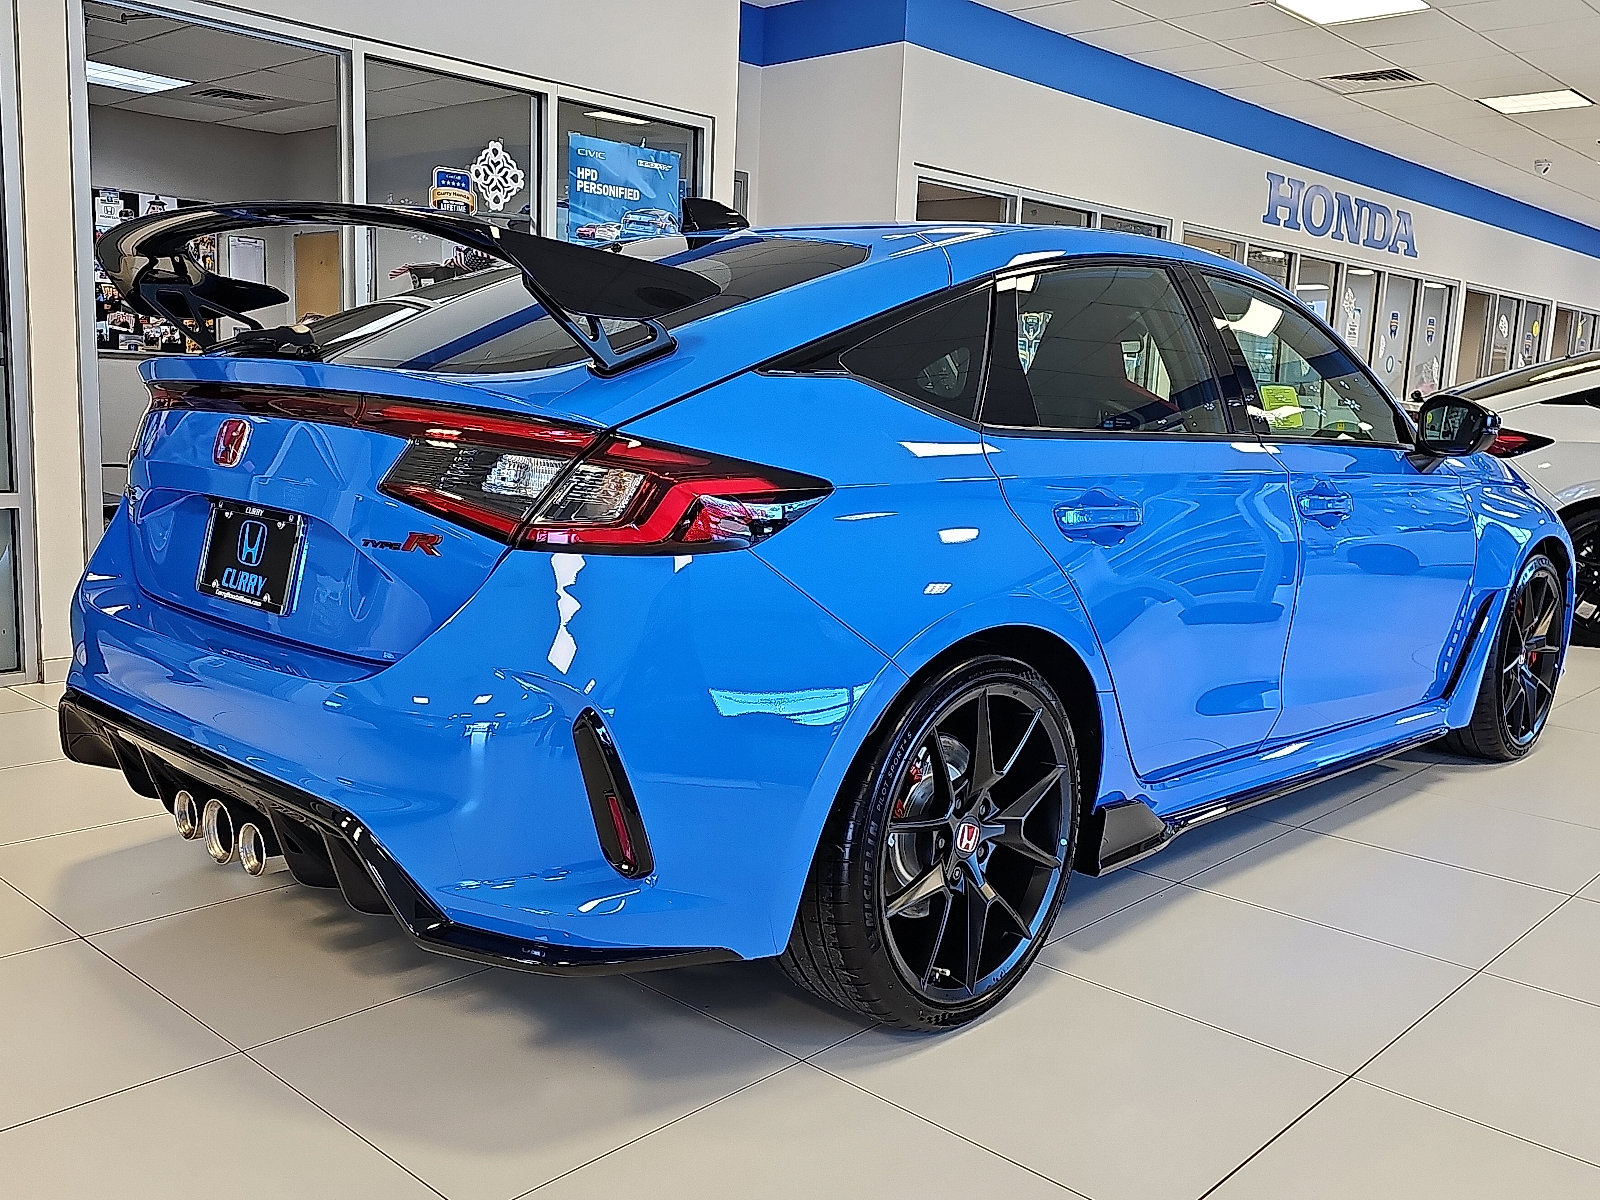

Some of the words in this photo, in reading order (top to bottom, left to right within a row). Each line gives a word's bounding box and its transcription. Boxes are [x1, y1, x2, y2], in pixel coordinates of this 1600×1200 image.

[577, 148, 606, 160] CIVIC
[577, 166, 598, 181] HPD
[452, 191, 470, 201] Honda
[576, 180, 640, 201] PERSONIFIED
[1262, 171, 1418, 258] HONDA
[245, 506, 265, 516] CURRY
[361, 538, 402, 551] TYPE
[401, 531, 443, 557] R
[221, 567, 267, 596] CURRY
[876, 780, 889, 812] PILOT
[863, 820, 879, 927] MICHELIN
